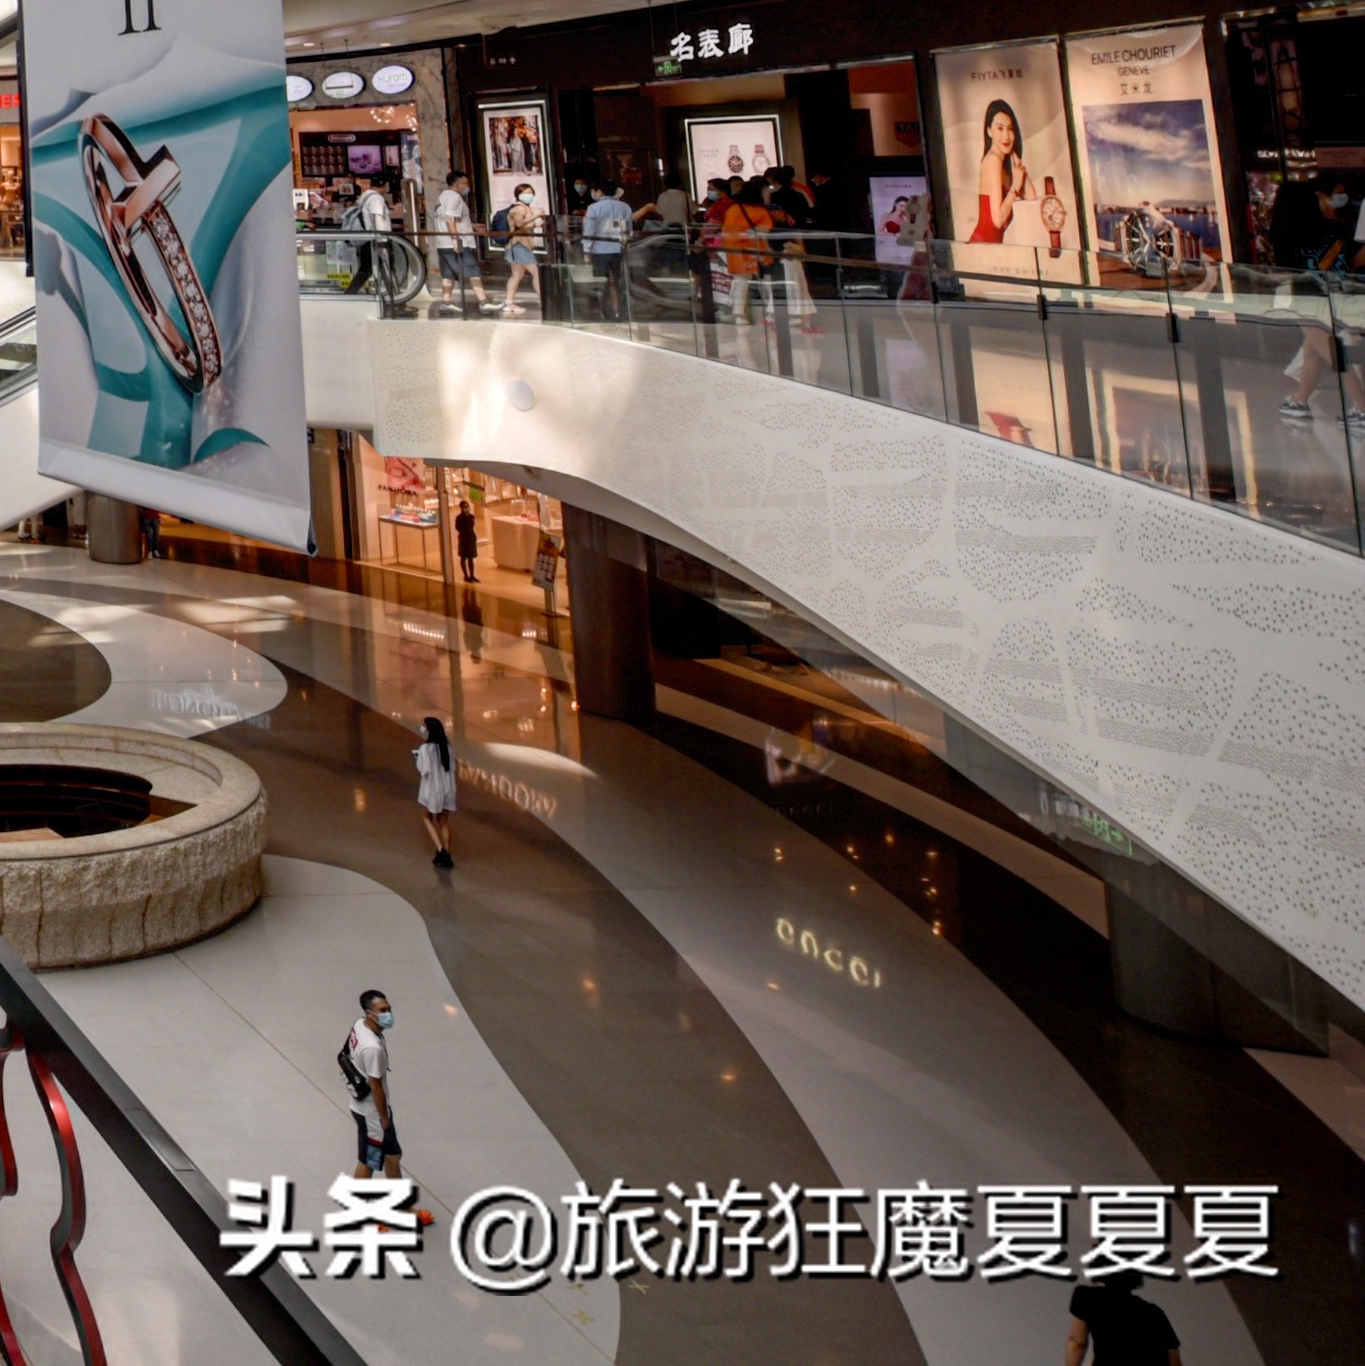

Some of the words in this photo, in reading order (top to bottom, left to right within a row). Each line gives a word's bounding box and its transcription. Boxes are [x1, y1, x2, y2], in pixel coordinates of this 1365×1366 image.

[670, 22, 754, 62] 名表廊
[1091, 49, 1120, 65] EMILE
[1122, 45, 1177, 62] CHOURIET
